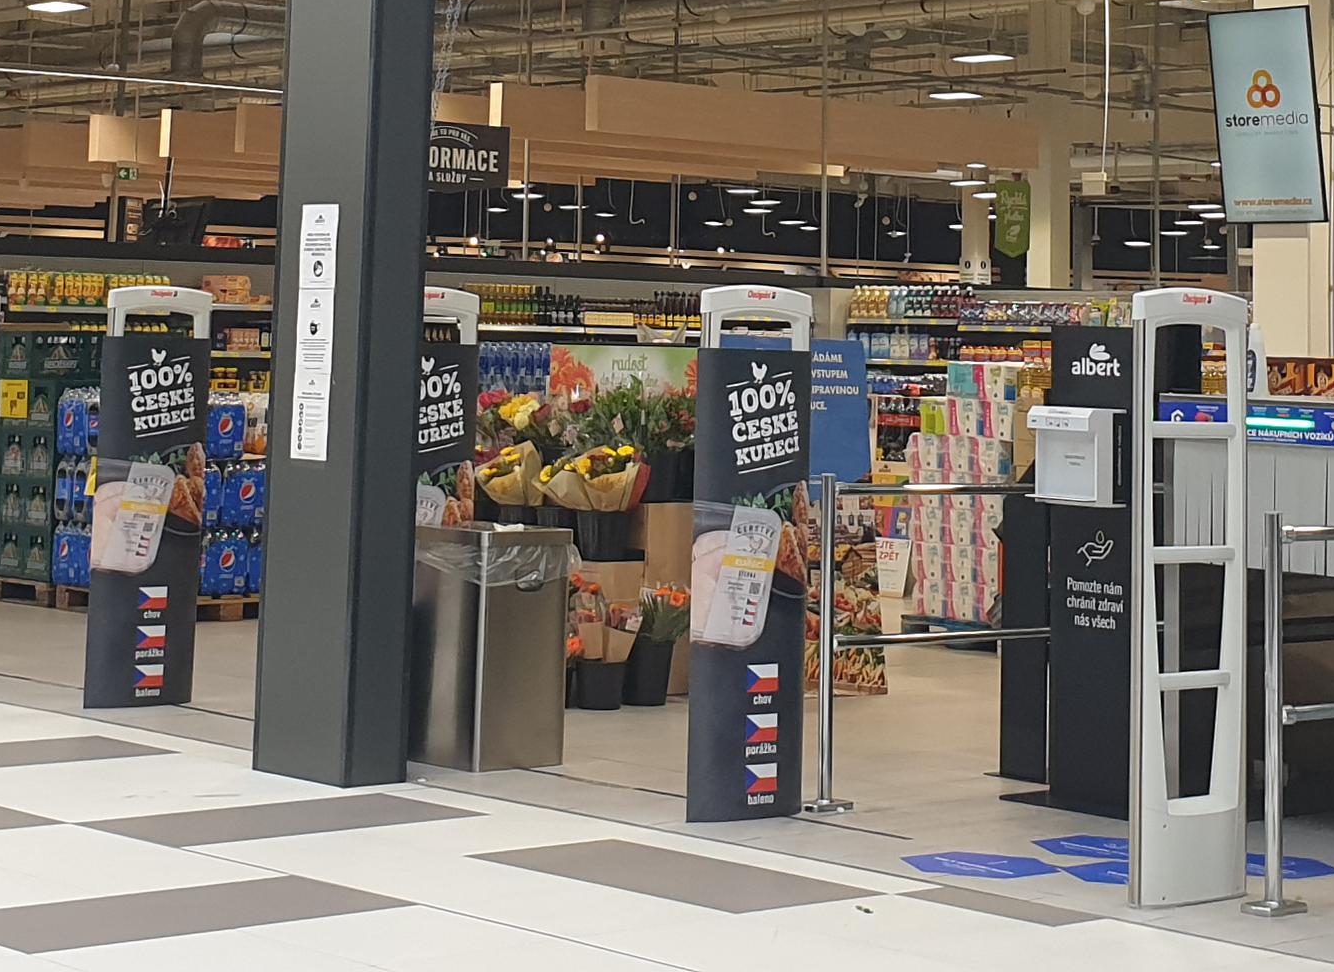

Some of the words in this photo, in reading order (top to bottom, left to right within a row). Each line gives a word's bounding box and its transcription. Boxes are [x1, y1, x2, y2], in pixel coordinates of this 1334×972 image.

[1225, 110, 1309, 128] storemedia
[429, 145, 499, 173] ORMACE
[436, 170, 467, 184] SLUŽBY
[812, 350, 844, 363] ÁDÁME
[1071, 357, 1121, 377] albert
[128, 362, 194, 393] 100%
[419, 371, 462, 401] 0%
[131, 382, 195, 413] ČESKÉ
[728, 379, 796, 418] 100%
[812, 385, 859, 395] IPRAVENOU
[133, 403, 196, 431] KUŘECÍ
[418, 394, 464, 425] ESKÉ
[417, 417, 465, 445] UŘECÍ
[732, 405, 799, 443] ČESKÉ
[735, 431, 800, 466] KUŘECÍ
[1067, 576, 1102, 594] Pomozte
[1103, 581, 1123, 596] nám
[143, 609, 161, 619] chov
[1067, 594, 1096, 611] chránit
[1098, 598, 1124, 614] zdraví
[1074, 613, 1090, 627] nás
[1091, 615, 1116, 630] všech
[753, 694, 772, 705] chov
[745, 742, 777, 758] porážka
[747, 794, 774, 805] baleno
